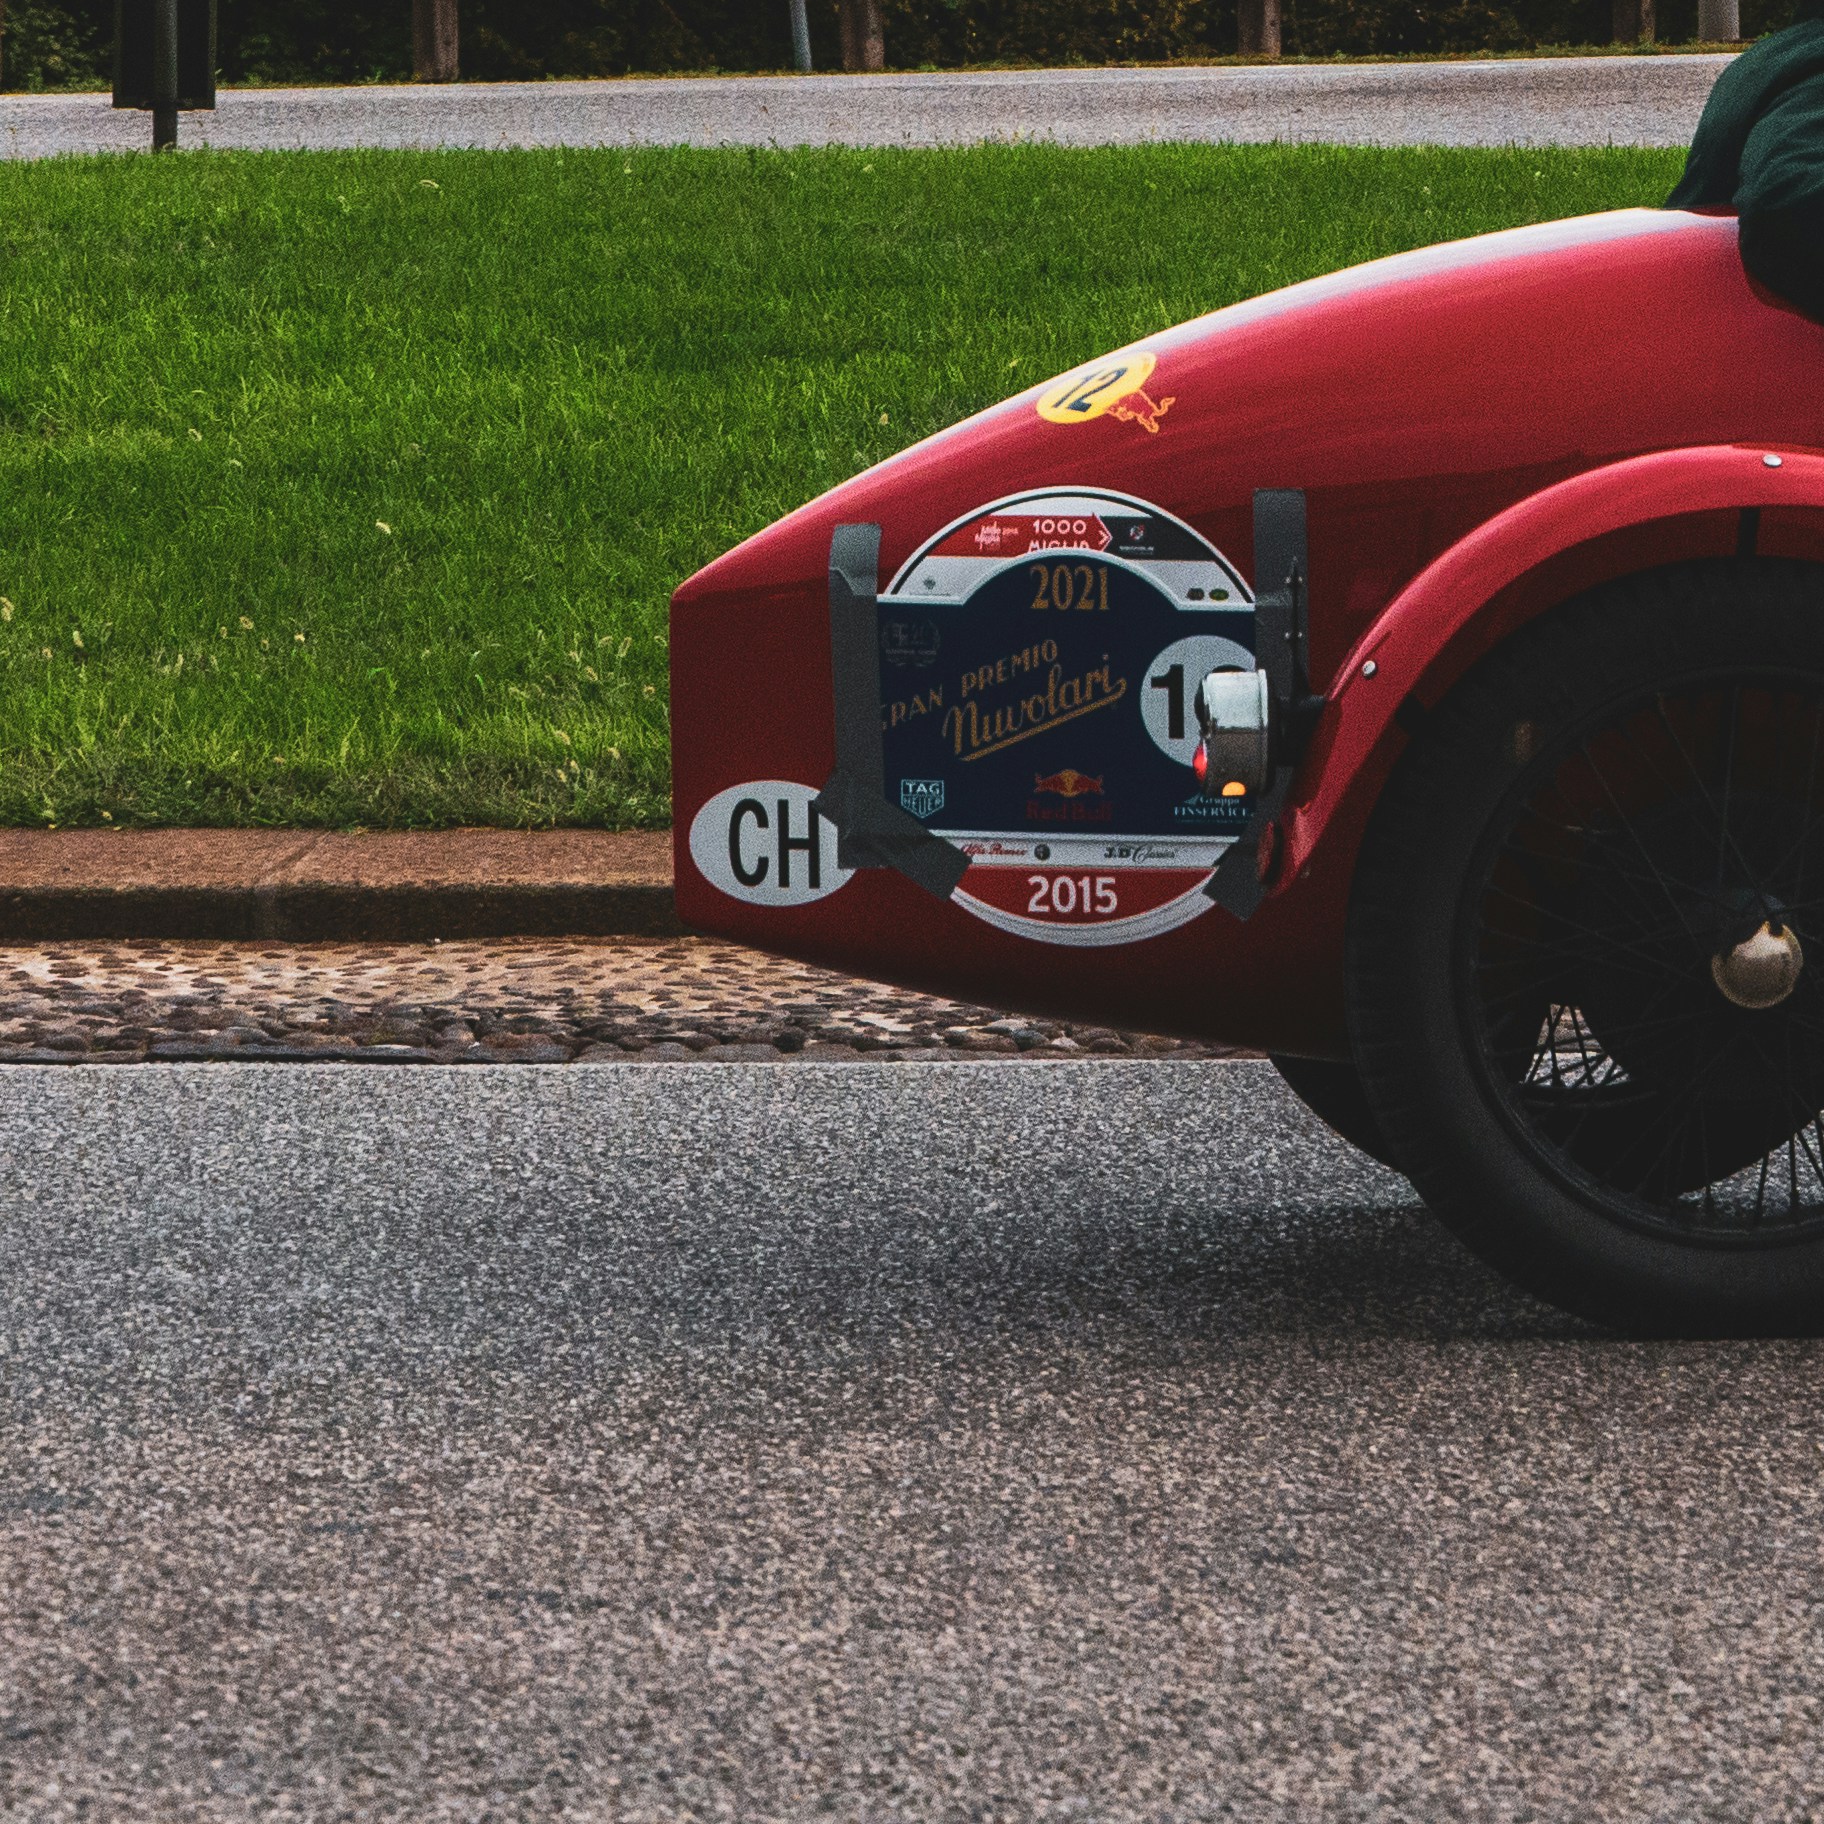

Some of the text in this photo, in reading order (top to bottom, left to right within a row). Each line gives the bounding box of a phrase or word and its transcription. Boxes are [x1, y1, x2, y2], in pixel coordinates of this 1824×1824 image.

[1051, 367, 1128, 413] 12
[1032, 519, 1087, 534] 1000
[1030, 564, 1110, 611] 2021
[879, 639, 1058, 730] RAN PREMIO
[941, 653, 1127, 758] Nuvolari
[905, 782, 940, 794] TAG
[728, 798, 822, 889] CH
[1027, 876, 1118, 914] 2015
